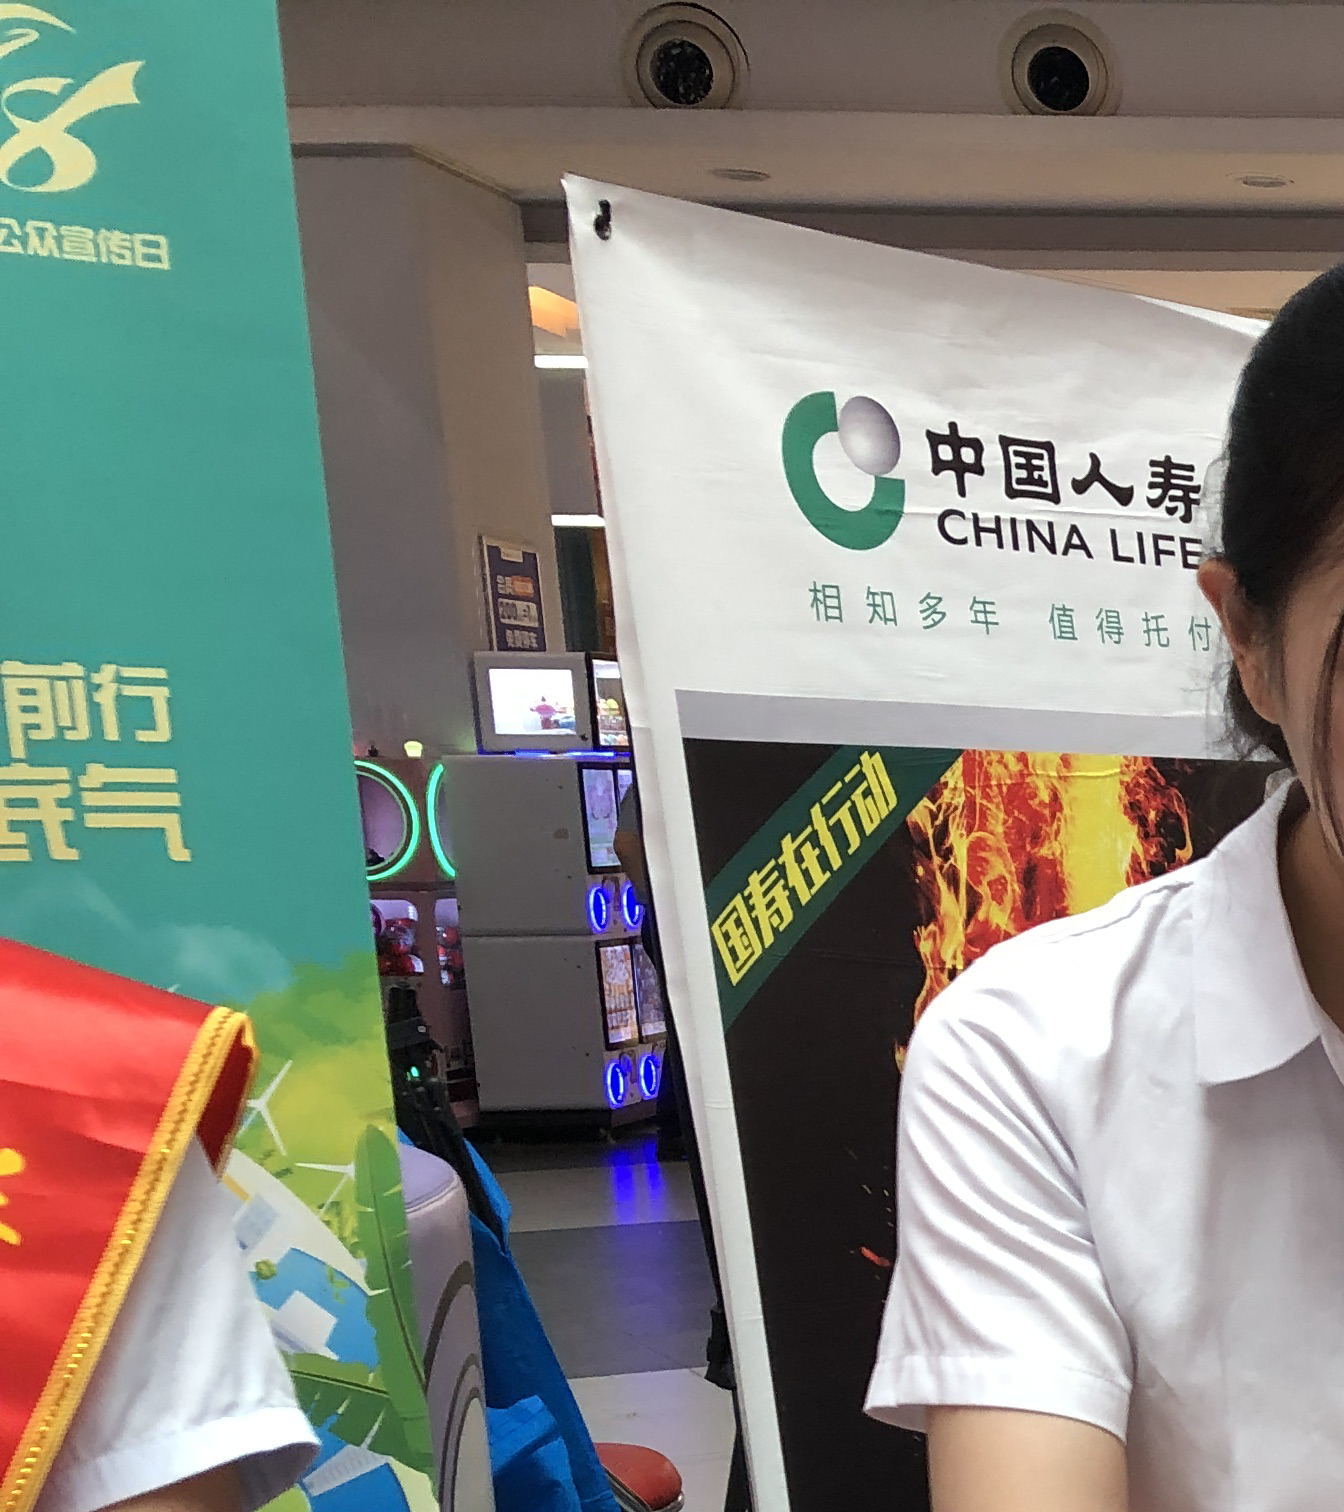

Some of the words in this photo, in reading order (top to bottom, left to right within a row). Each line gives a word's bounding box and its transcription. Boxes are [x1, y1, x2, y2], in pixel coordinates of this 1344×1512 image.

[0, 217, 171, 270] 公众宣传日
[926, 421, 1201, 523] 中国人寿
[937, 508, 1094, 559] CHINA
[1109, 528, 1202, 570] LIFE
[808, 580, 1000, 635] 相知多年
[1049, 602, 1213, 652] 值得托付
[0, 660, 171, 759] 前行
[0, 763, 192, 862] 底气
[710, 749, 899, 987] 国寿在行动
